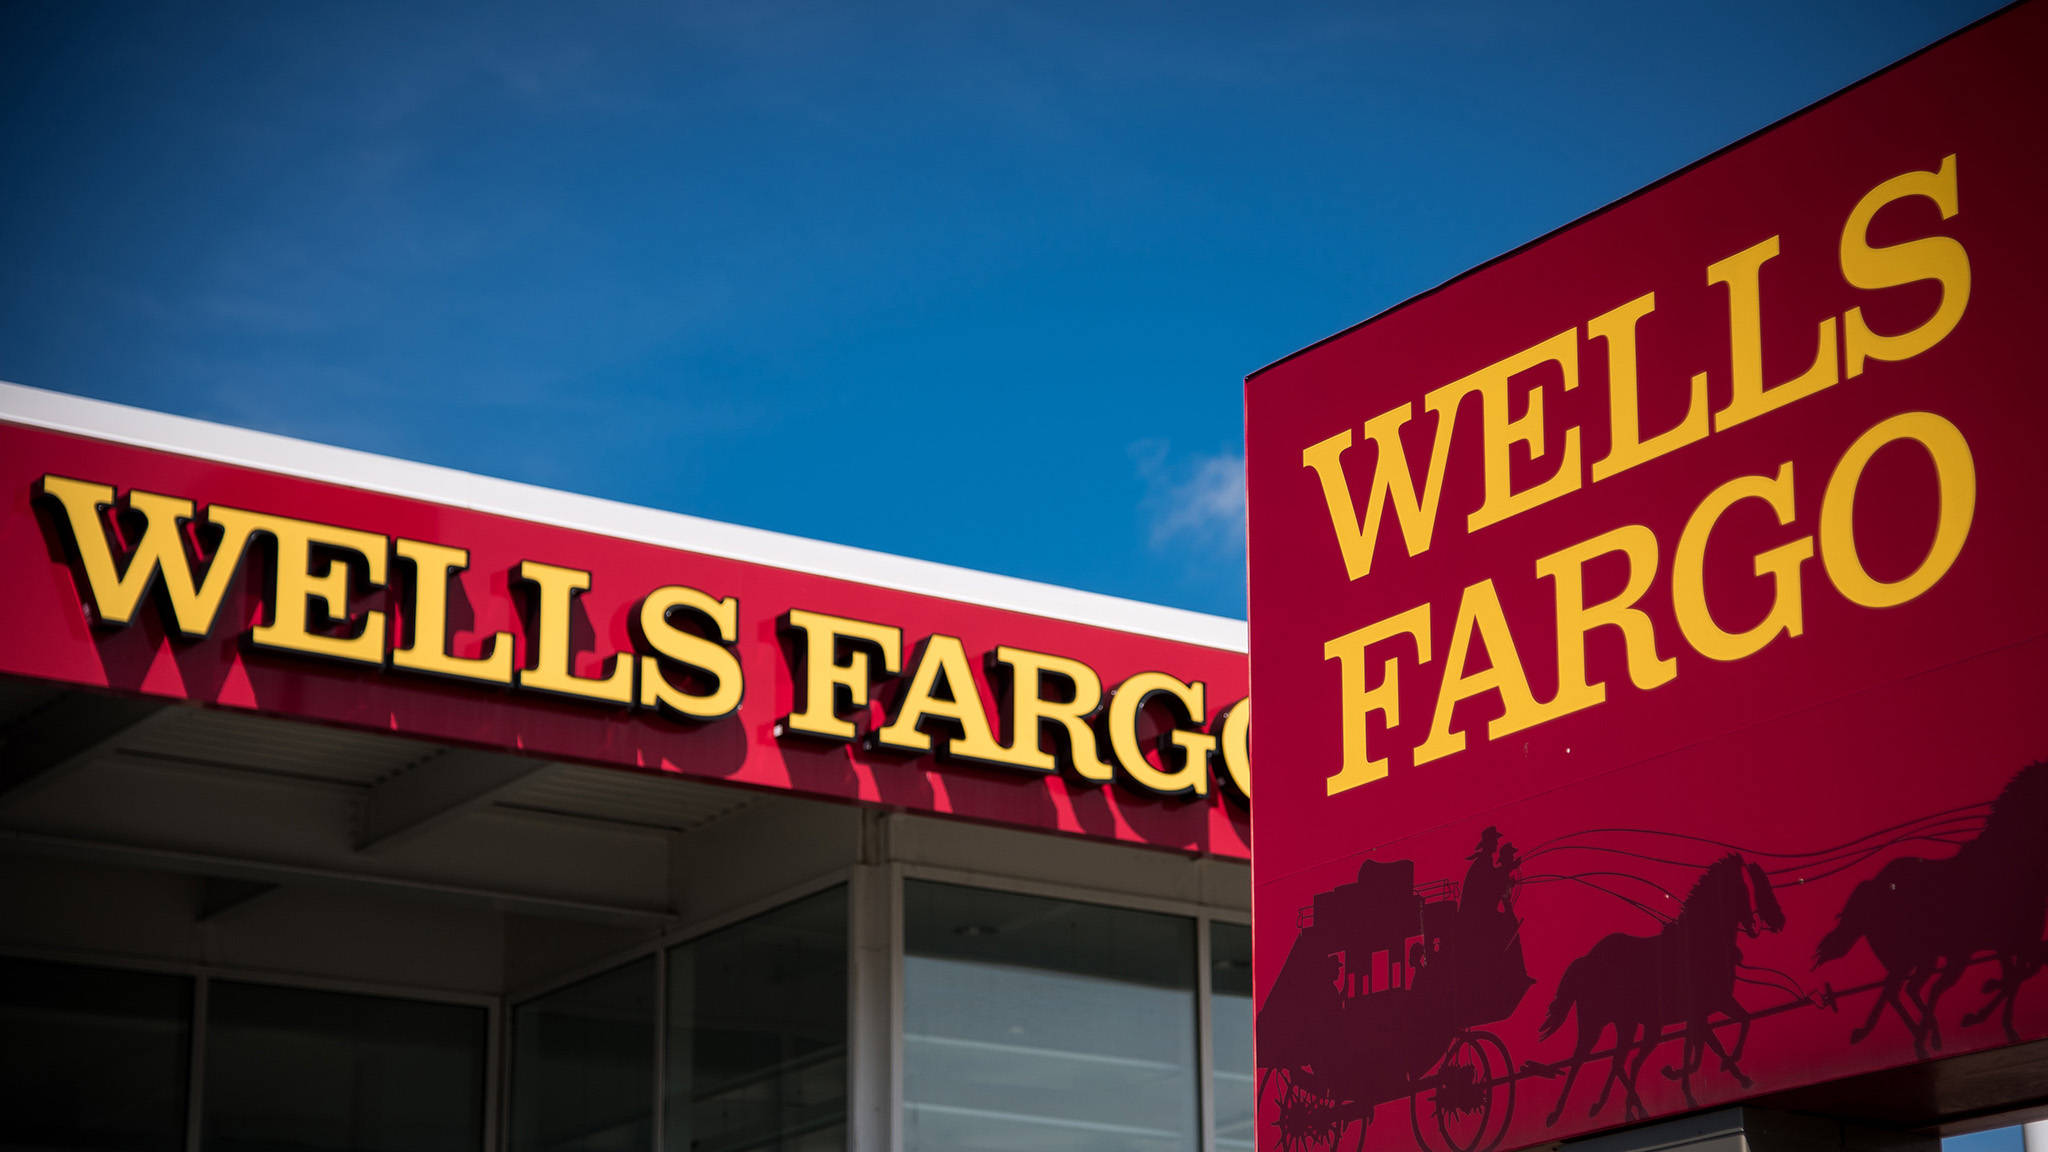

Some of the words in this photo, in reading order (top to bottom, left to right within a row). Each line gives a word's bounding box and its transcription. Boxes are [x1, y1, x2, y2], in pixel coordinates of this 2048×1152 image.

[1302, 154, 1972, 581] WELLS
[42, 475, 744, 719] WELLS
[787, 608, 1251, 799] FARG
[1324, 412, 1977, 796] FARGO
